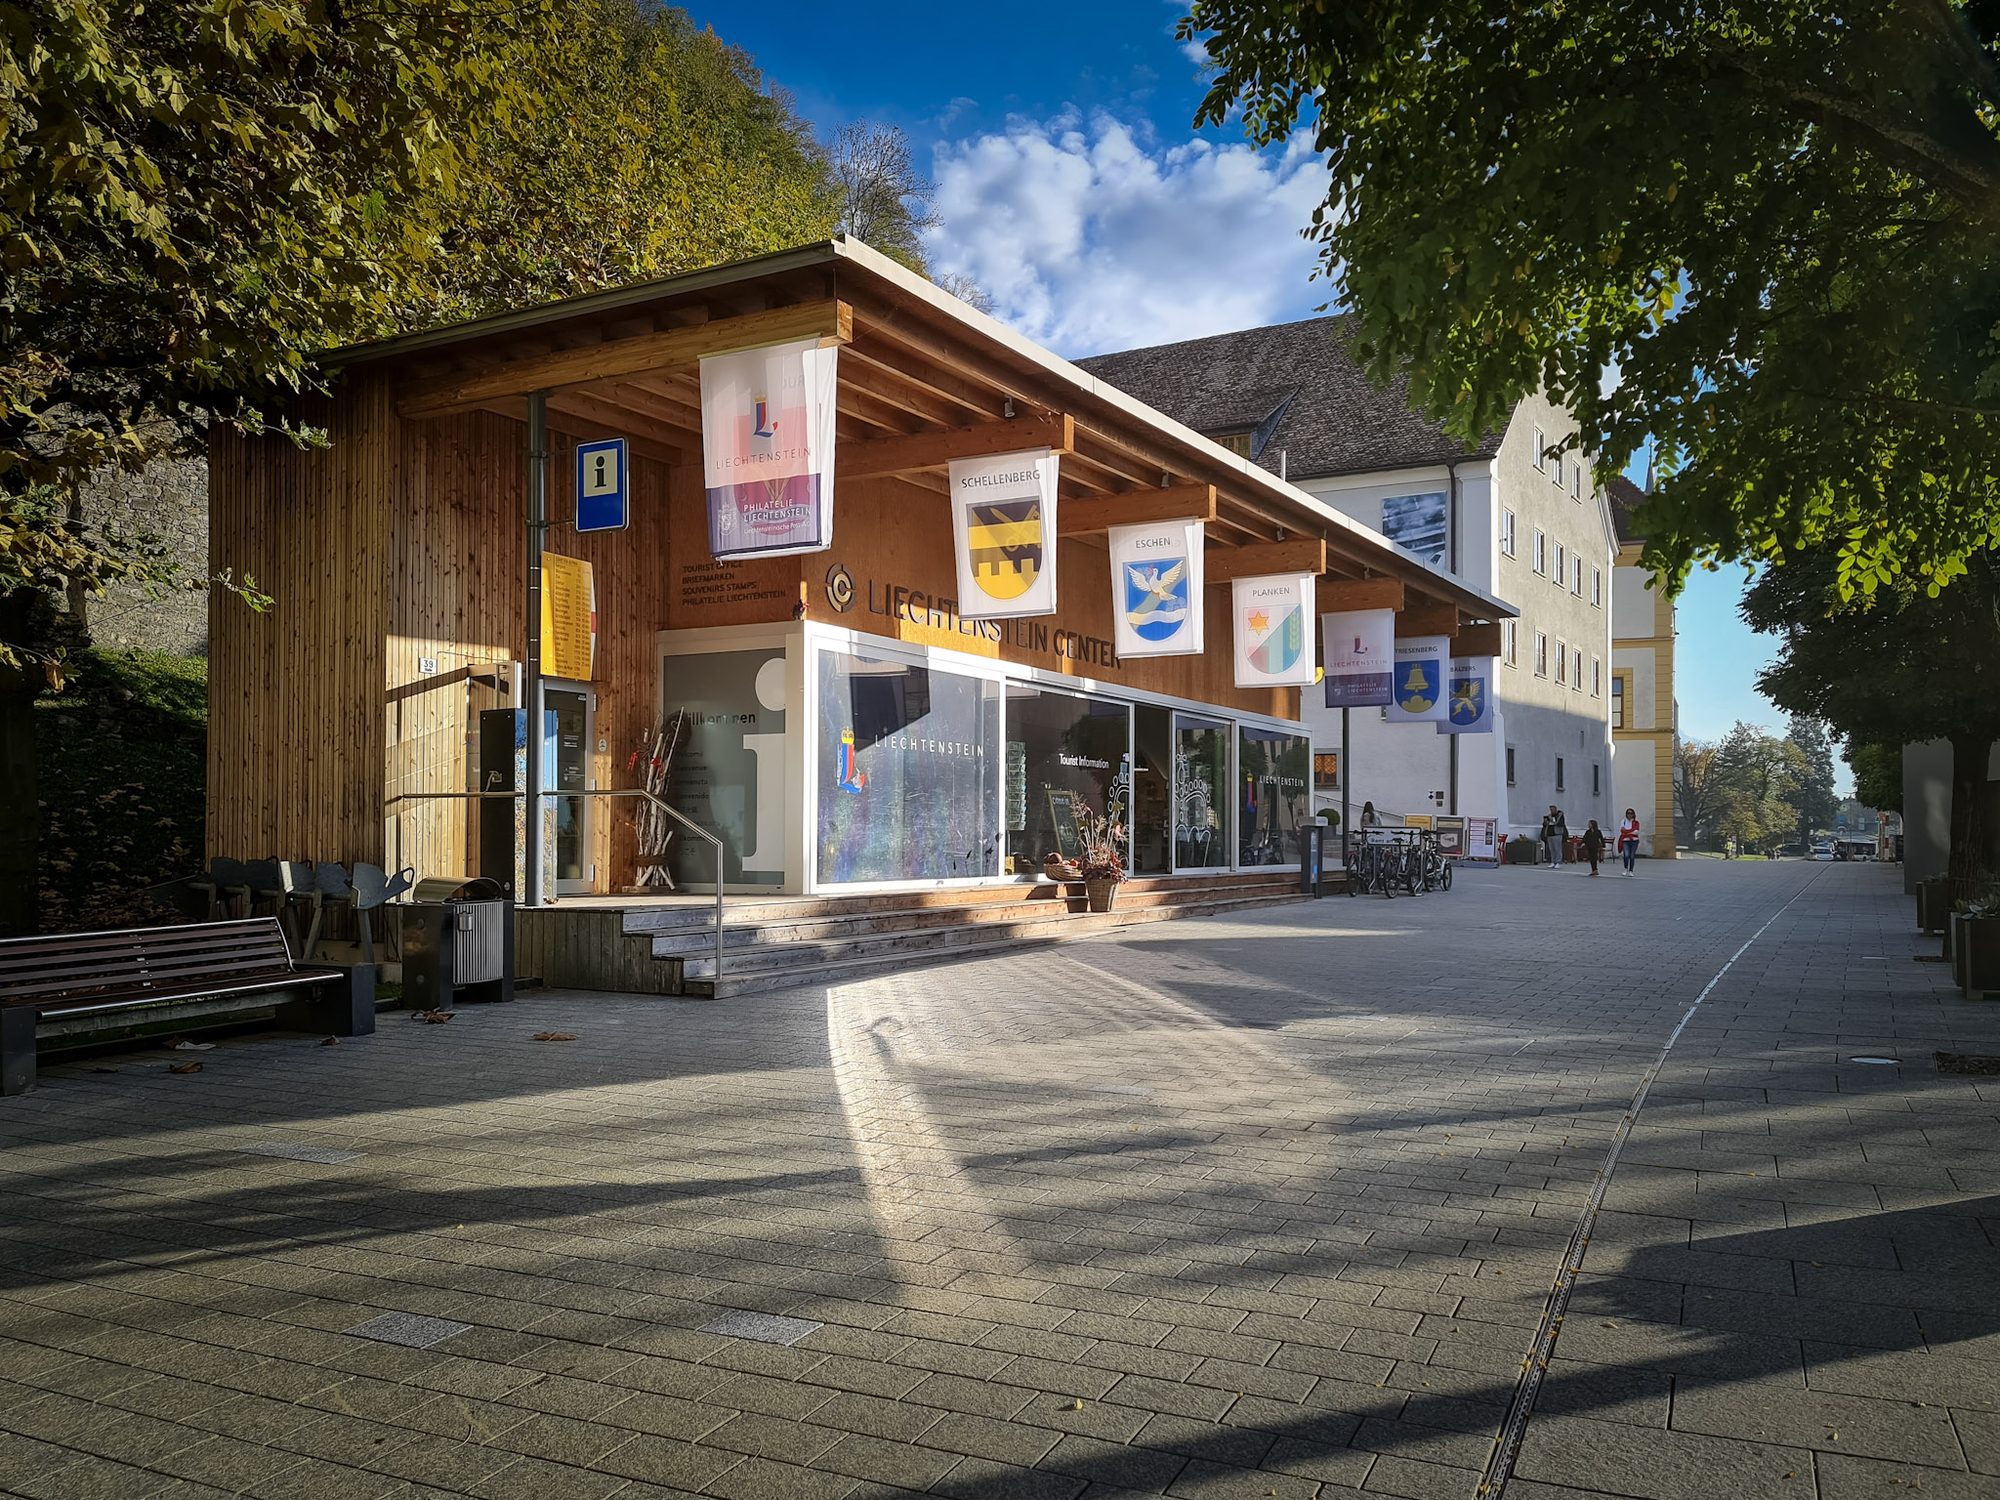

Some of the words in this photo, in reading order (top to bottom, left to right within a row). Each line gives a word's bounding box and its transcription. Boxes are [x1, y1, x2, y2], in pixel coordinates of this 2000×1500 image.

[716, 447, 811, 470] LIECHTENSTEIN
[961, 469, 1041, 489] SCHELLENBERG
[743, 499, 793, 512] PHILATELIE
[743, 507, 811, 522] LIECHTENSTEIN
[1135, 537, 1171, 549] ESCHEN
[683, 563, 714, 573] TOURIST
[682, 572, 735, 585] BRIEFMARKEN
[682, 585, 725, 596] SOUVENIRS
[726, 581, 757, 592] STAMPS
[1252, 586, 1290, 597] PLANKEN
[682, 595, 725, 606] PHILATELIE
[726, 589, 786, 602] LIECHTENSTEIN
[1053, 629, 1122, 669] CENTER
[1395, 646, 1438, 655] TRIESENBERG
[424, 659, 434, 668] 39
[1330, 660, 1387, 668] LIECHTENSTEIN
[686, 712, 756, 727] illkommen
[875, 734, 984, 757] LIECHTENSTEIN
[1059, 753, 1078, 766] Tourist
[1079, 755, 1109, 769] Information
[1259, 775, 1304, 787] LIECHTENSTEIN
